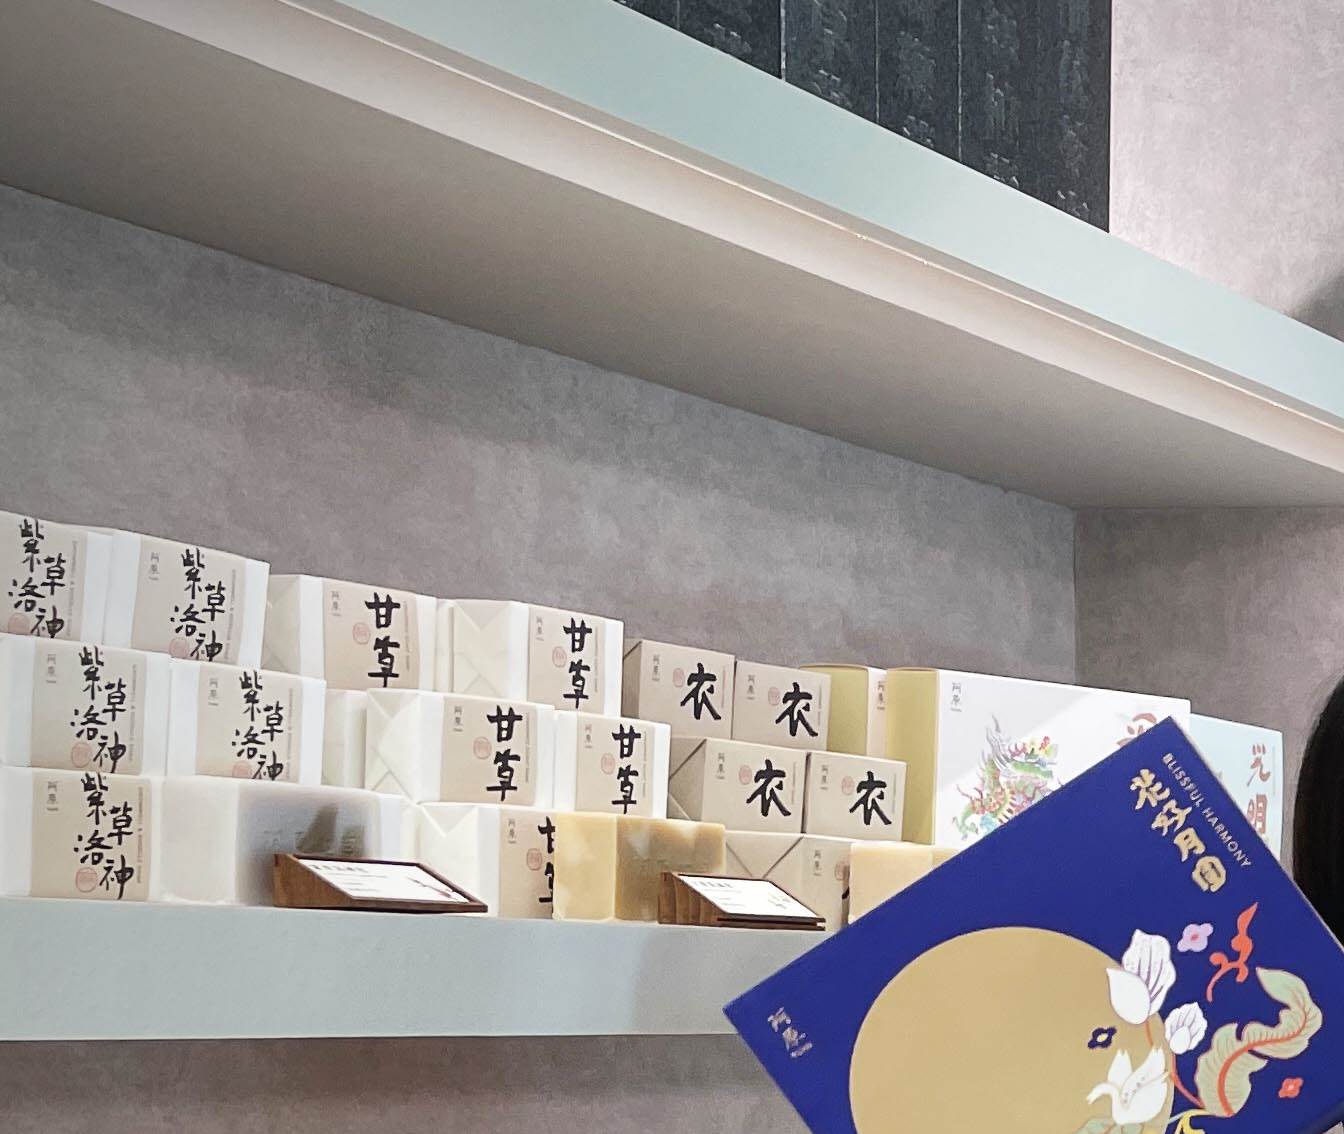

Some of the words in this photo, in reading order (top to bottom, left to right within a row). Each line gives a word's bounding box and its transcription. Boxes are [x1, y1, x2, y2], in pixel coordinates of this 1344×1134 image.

[8, 518, 66, 639] 紫草洛神
[170, 547, 226, 662] 紫草洛神
[364, 591, 401, 689] 甘草
[563, 616, 593, 709] 甘草
[70, 646, 127, 773] 紫草洛神
[231, 670, 285, 780] 紫草洛神
[680, 662, 722, 720] 衣
[775, 682, 819, 737] 衣
[486, 704, 523, 802] 甘草
[611, 723, 642, 815] 甘草
[746, 759, 792, 817] 衣
[849, 770, 893, 826] 衣
[73, 772, 135, 900] 紫草洛神
[1161, 752, 1205, 810] BLISSFUL
[1201, 805, 1253, 868] HARMONY
